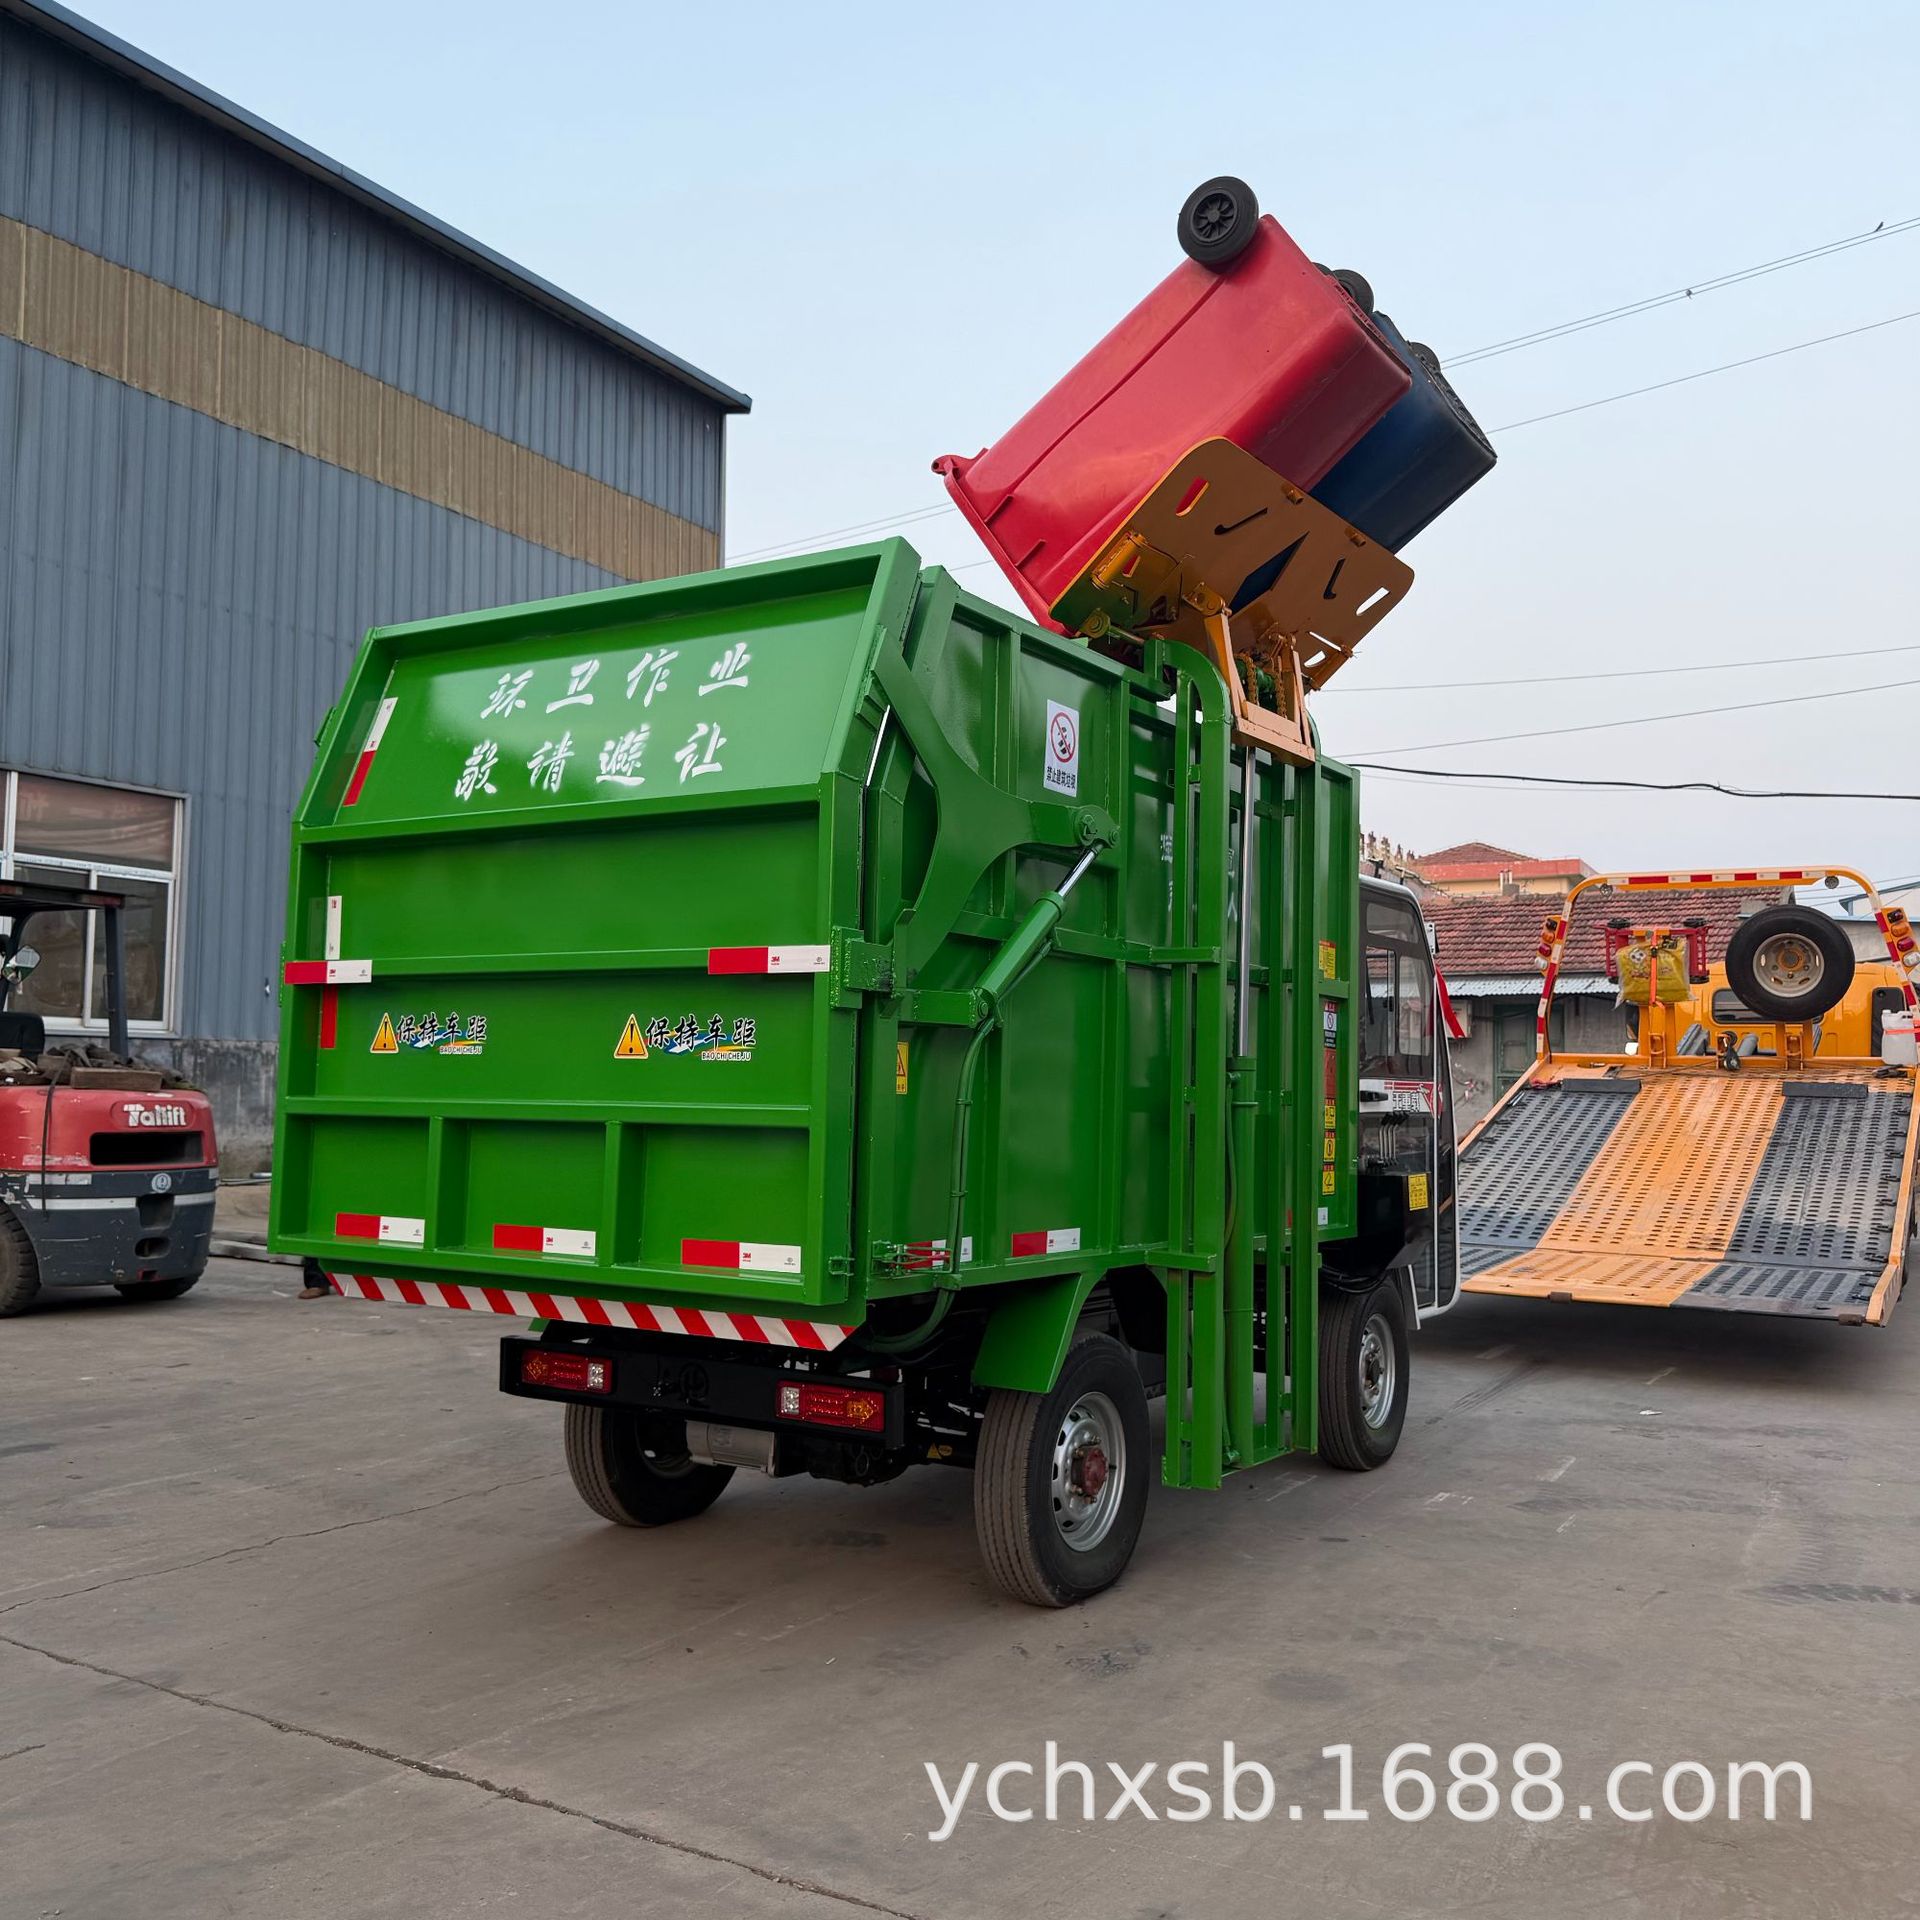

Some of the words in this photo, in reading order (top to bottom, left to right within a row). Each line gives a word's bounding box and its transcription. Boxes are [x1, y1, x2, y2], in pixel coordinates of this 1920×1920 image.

[480, 642, 751, 719] 环卫作业
[455, 722, 727, 801] 敬请避让
[396, 1012, 487, 1047] 保持车距
[645, 1014, 757, 1051] 保持车距
[702, 1052, 715, 1060] BAO
[716, 1052, 727, 1060] CHI
[728, 1052, 741, 1060] CHE
[741, 1052, 751, 1061] JU
